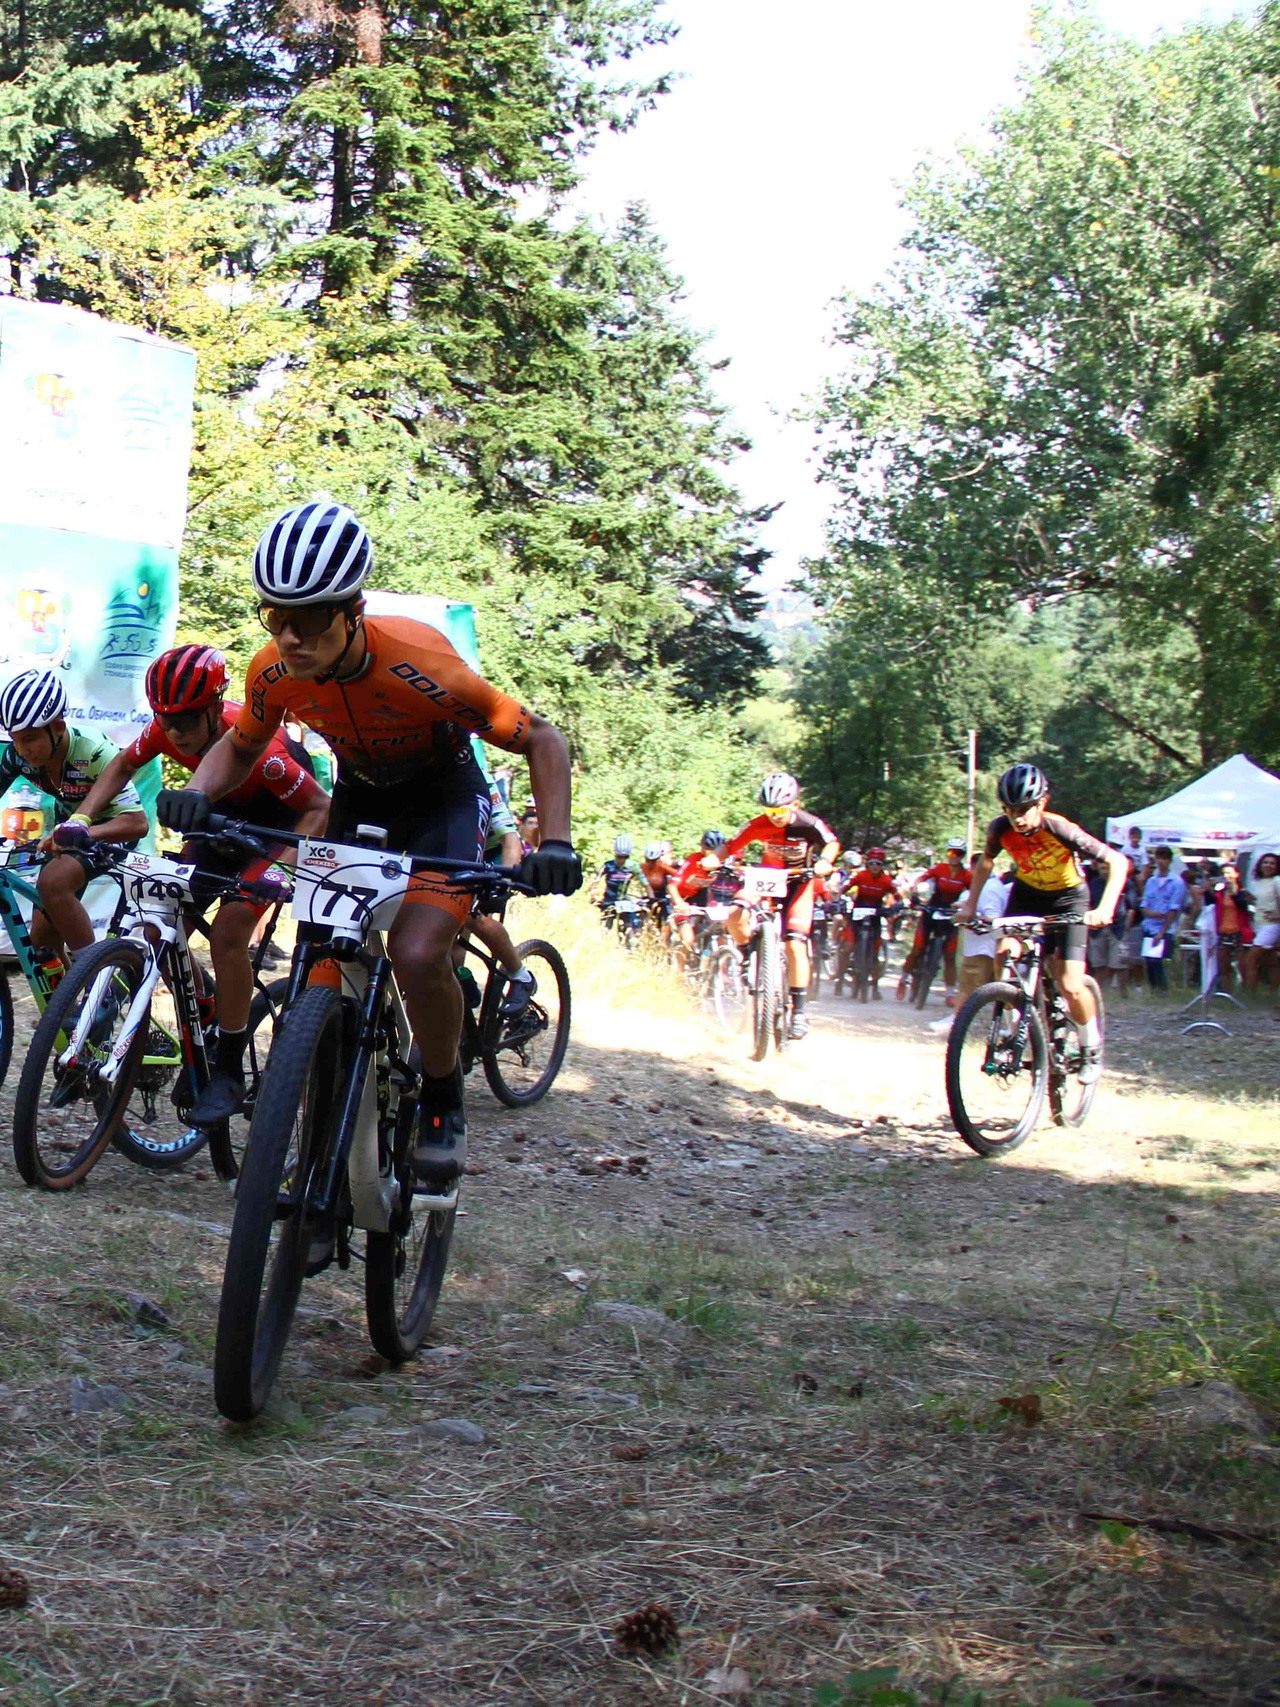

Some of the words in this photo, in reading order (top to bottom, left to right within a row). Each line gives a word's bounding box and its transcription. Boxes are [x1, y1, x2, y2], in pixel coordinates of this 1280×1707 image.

[250, 659, 288, 723] DOLTCI
[88, 705, 127, 722] Обичам
[279, 769, 305, 801] MAXXIS
[131, 876, 185, 901] 140
[756, 881, 776, 893] 82
[321, 881, 379, 922] 77
